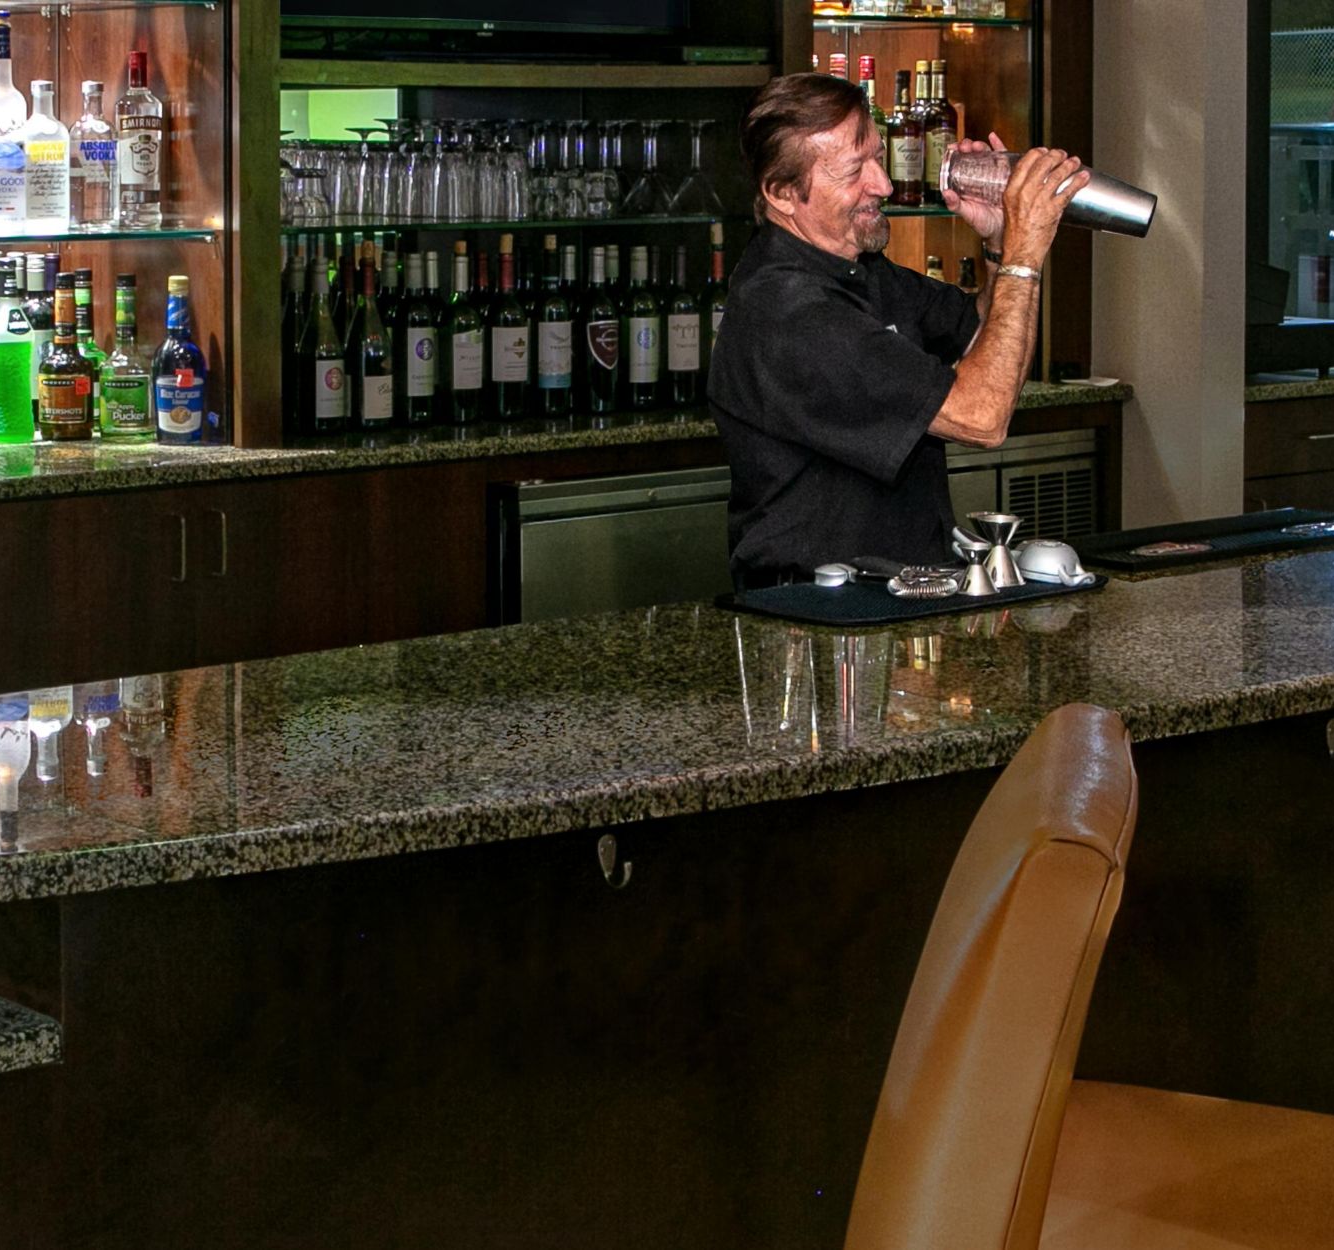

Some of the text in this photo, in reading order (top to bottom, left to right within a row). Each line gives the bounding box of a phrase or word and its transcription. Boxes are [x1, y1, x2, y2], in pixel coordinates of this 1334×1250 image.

[80, 141, 117, 150] ABSOLUT
[84, 150, 117, 160] VODKA
[0, 177, 25, 185] GOOS
[113, 410, 146, 420] Pucker
